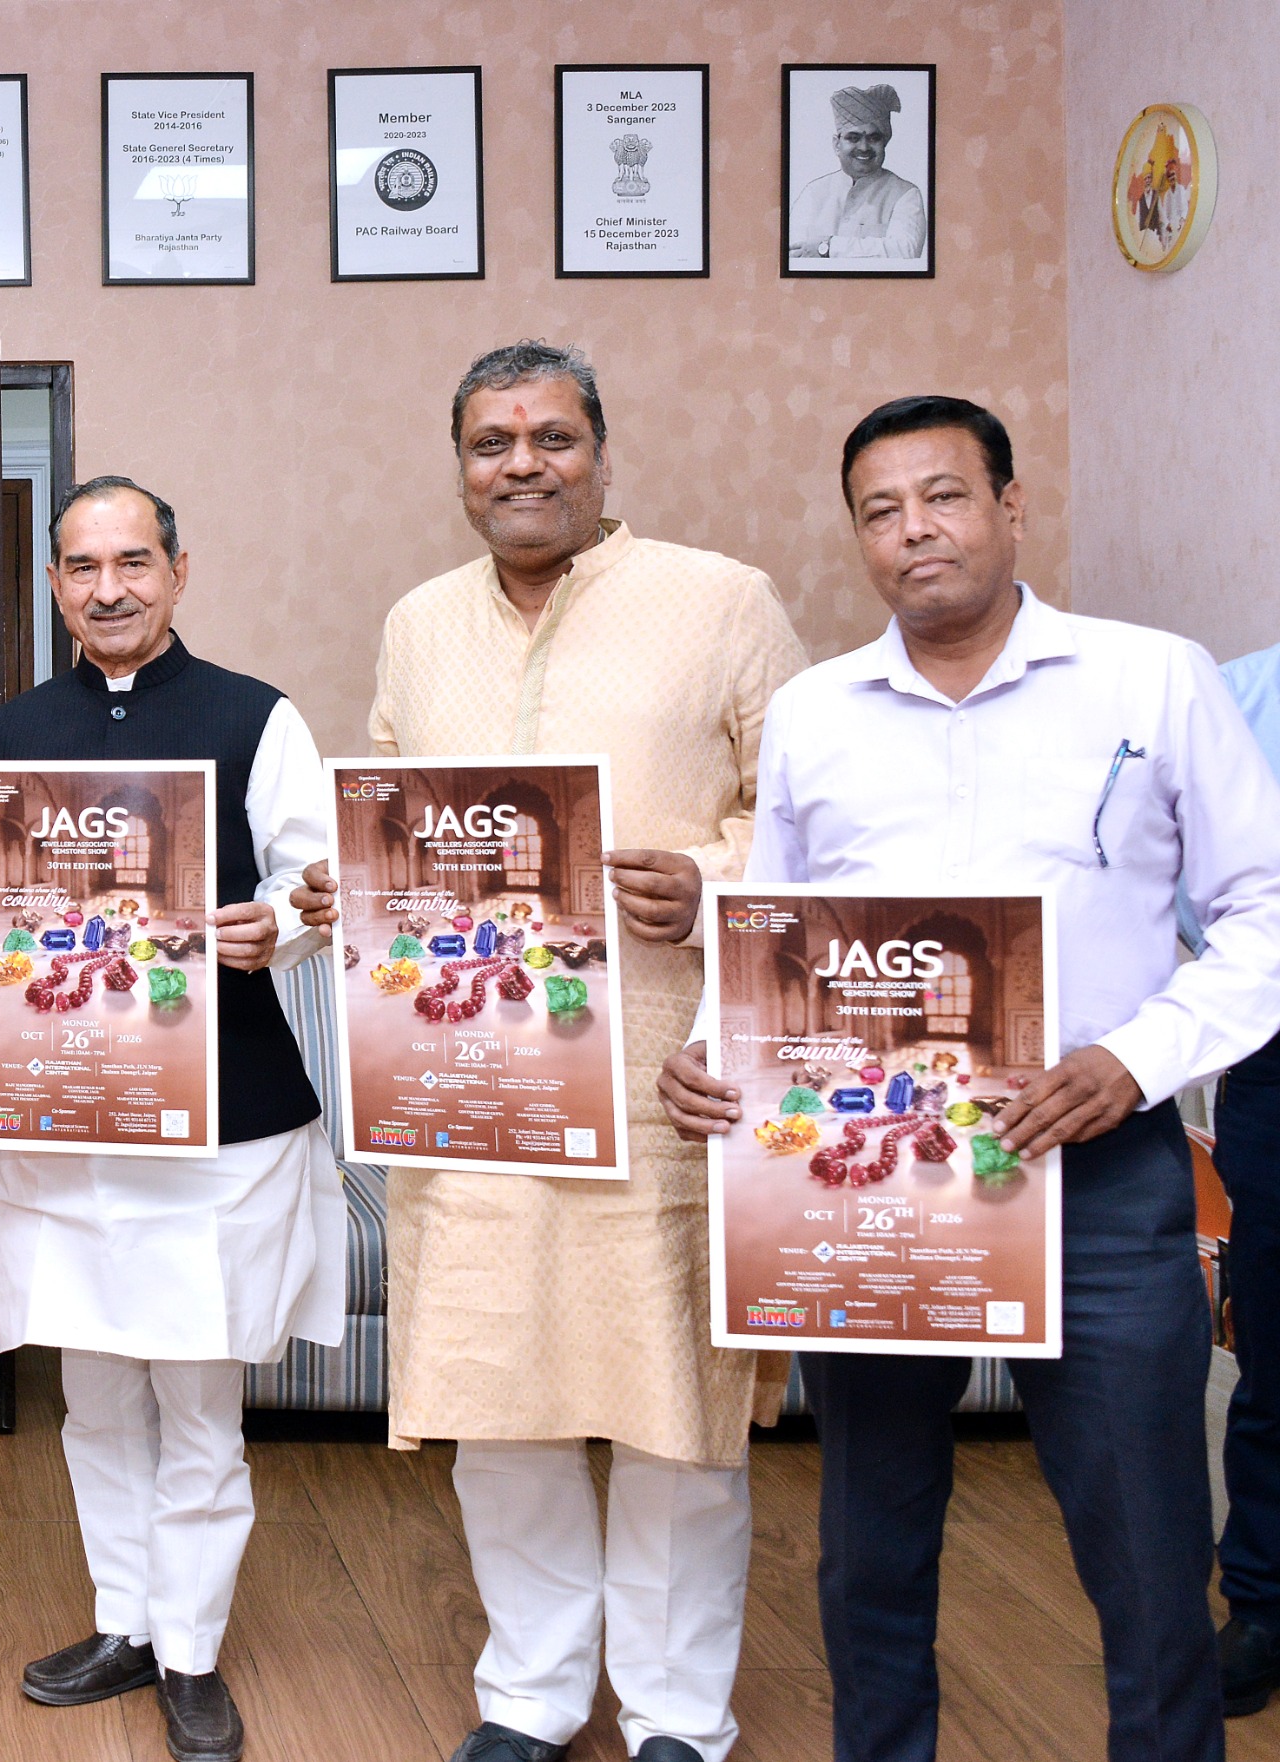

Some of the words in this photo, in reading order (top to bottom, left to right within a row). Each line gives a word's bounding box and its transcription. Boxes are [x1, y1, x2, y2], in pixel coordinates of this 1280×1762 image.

[620, 91, 643, 100] MLA
[587, 103, 593, 112] 3
[595, 103, 649, 112] December
[651, 102, 676, 112] 2023
[131, 111, 156, 119] State
[180, 111, 225, 119] President
[379, 112, 432, 123] Member
[607, 115, 656, 126] Sanganer
[122, 144, 147, 152] State
[188, 144, 234, 154] Secretary
[132, 155, 180, 163] 2016-2023
[182, 155, 191, 165] (4
[194, 155, 225, 164] Times)
[401, 151, 427, 164] INDIAN
[423, 162, 436, 198] RAILWAYS
[595, 217, 623, 226] Chief
[626, 218, 667, 226] Minister
[355, 226, 378, 236] PAC
[381, 226, 423, 237] Railway
[425, 225, 458, 234] Board
[584, 230, 596, 238] 15
[599, 230, 652, 238] December
[654, 229, 679, 238] 2023
[135, 234, 174, 243] Bharatiya
[200, 234, 222, 242] Party
[158, 244, 199, 252] Rajasthan
[606, 241, 657, 252] Rajasthan
[31, 807, 129, 839] JAGS
[414, 805, 518, 838] JAGS
[47, 862, 71, 870] 30TH
[73, 862, 112, 870] EDITION
[432, 863, 458, 871] 30TH
[460, 863, 502, 871] EDITION
[815, 939, 943, 979] JAGS
[836, 1005, 868, 1016] 30TH
[871, 1007, 922, 1016] EDITION
[21, 1031, 44, 1040] OCT
[117, 1034, 142, 1043] 2026
[412, 1043, 436, 1052] OCT
[514, 1047, 540, 1056] 2026
[370, 1127, 416, 1146] RMC
[858, 1196, 907, 1205] MONDAY
[804, 1210, 835, 1220] OCT
[930, 1213, 962, 1224] 2026
[747, 1306, 805, 1327] RMC
